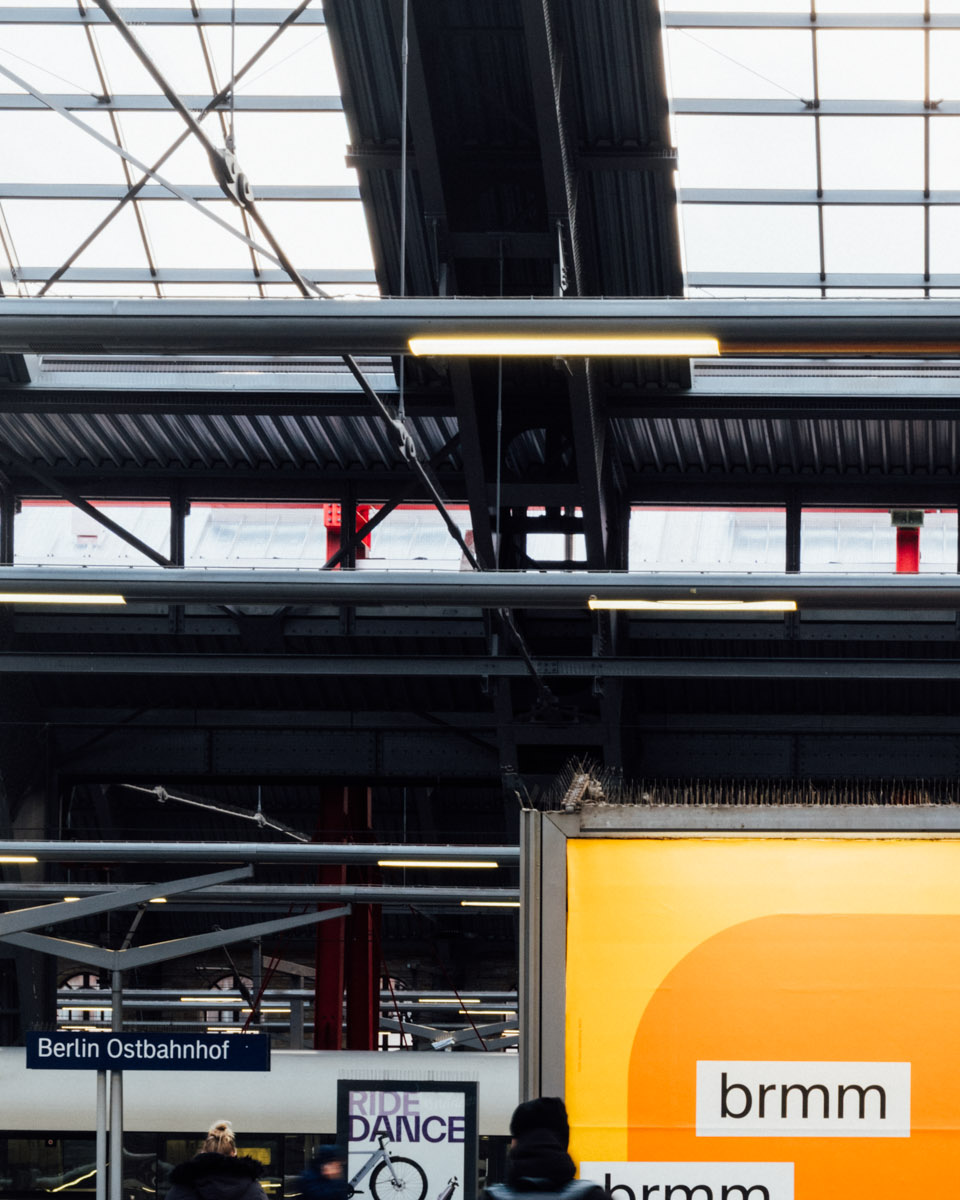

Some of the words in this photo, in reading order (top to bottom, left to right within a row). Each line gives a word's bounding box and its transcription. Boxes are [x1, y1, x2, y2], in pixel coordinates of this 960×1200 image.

[38, 1037, 100, 1058] Berlin
[106, 1038, 230, 1060] Ostbahnhof
[348, 1091, 420, 1116] RIDE
[720, 1072, 888, 1120] brmm
[348, 1115, 465, 1143] DANCE
